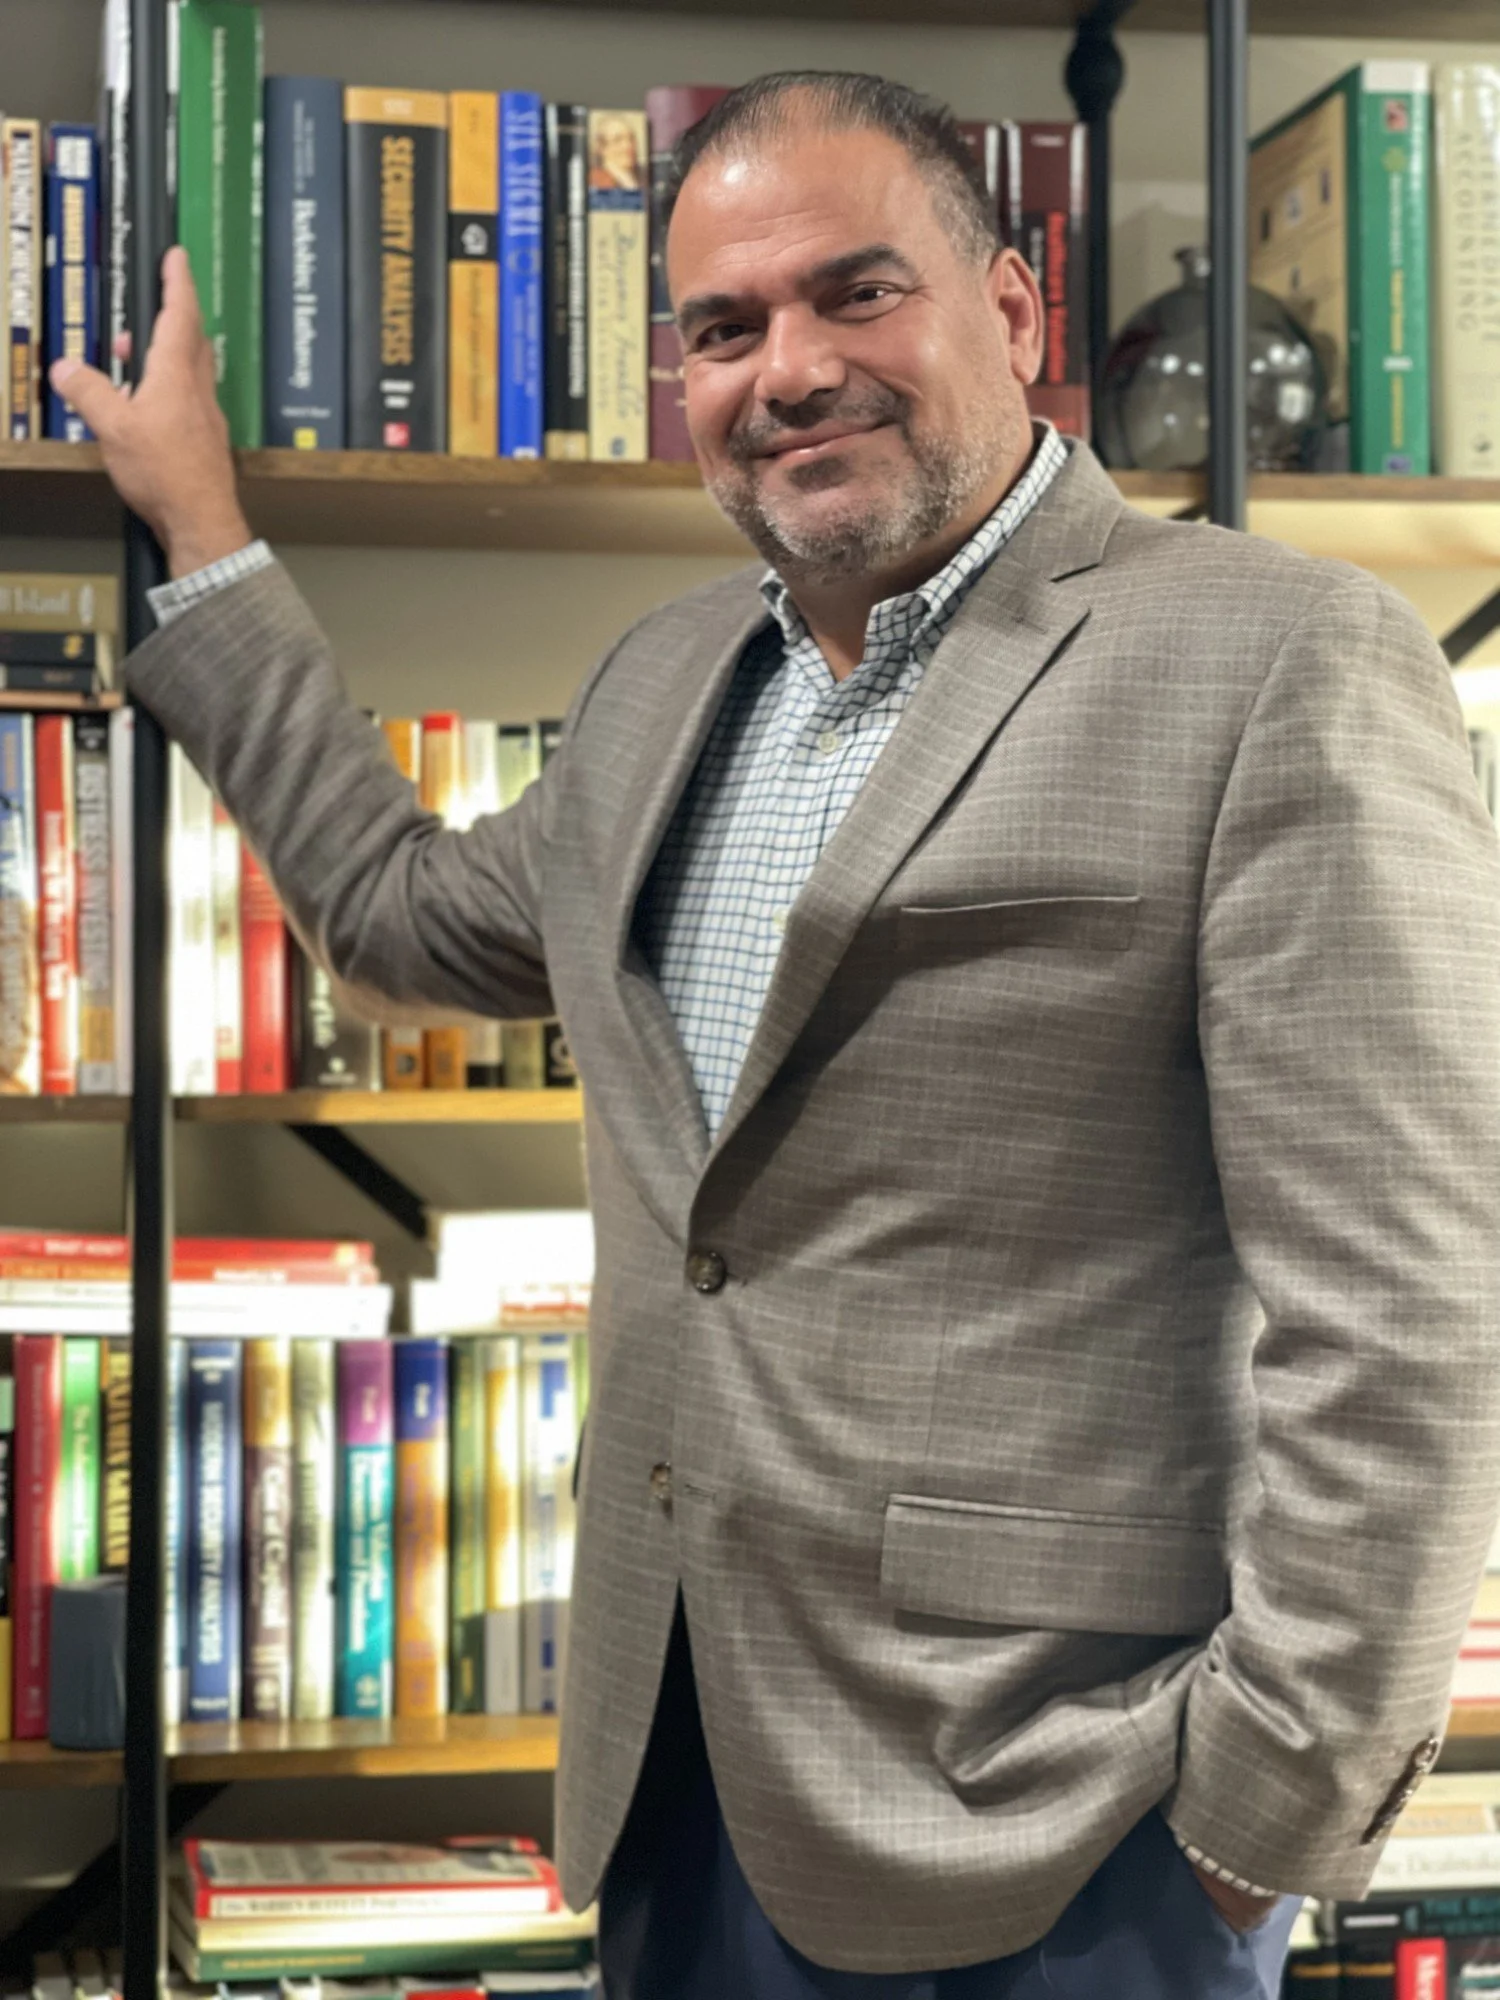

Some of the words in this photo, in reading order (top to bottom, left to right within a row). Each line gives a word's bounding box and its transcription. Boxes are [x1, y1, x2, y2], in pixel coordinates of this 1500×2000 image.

[381, 136, 415, 252] SECURITY
[1455, 132, 1476, 332] ACCOUNTING
[292, 199, 317, 290] Berkshire
[288, 294, 317, 388] Hathaway
[381, 253, 415, 365] ANALYSIS
[200, 1485, 223, 1574] SECURITY
[263, 1466, 285, 1512] Cost
[263, 1516, 285, 1536] of
[200, 1576, 223, 1664] ANALYSIS
[260, 1540, 286, 1627] Capital
